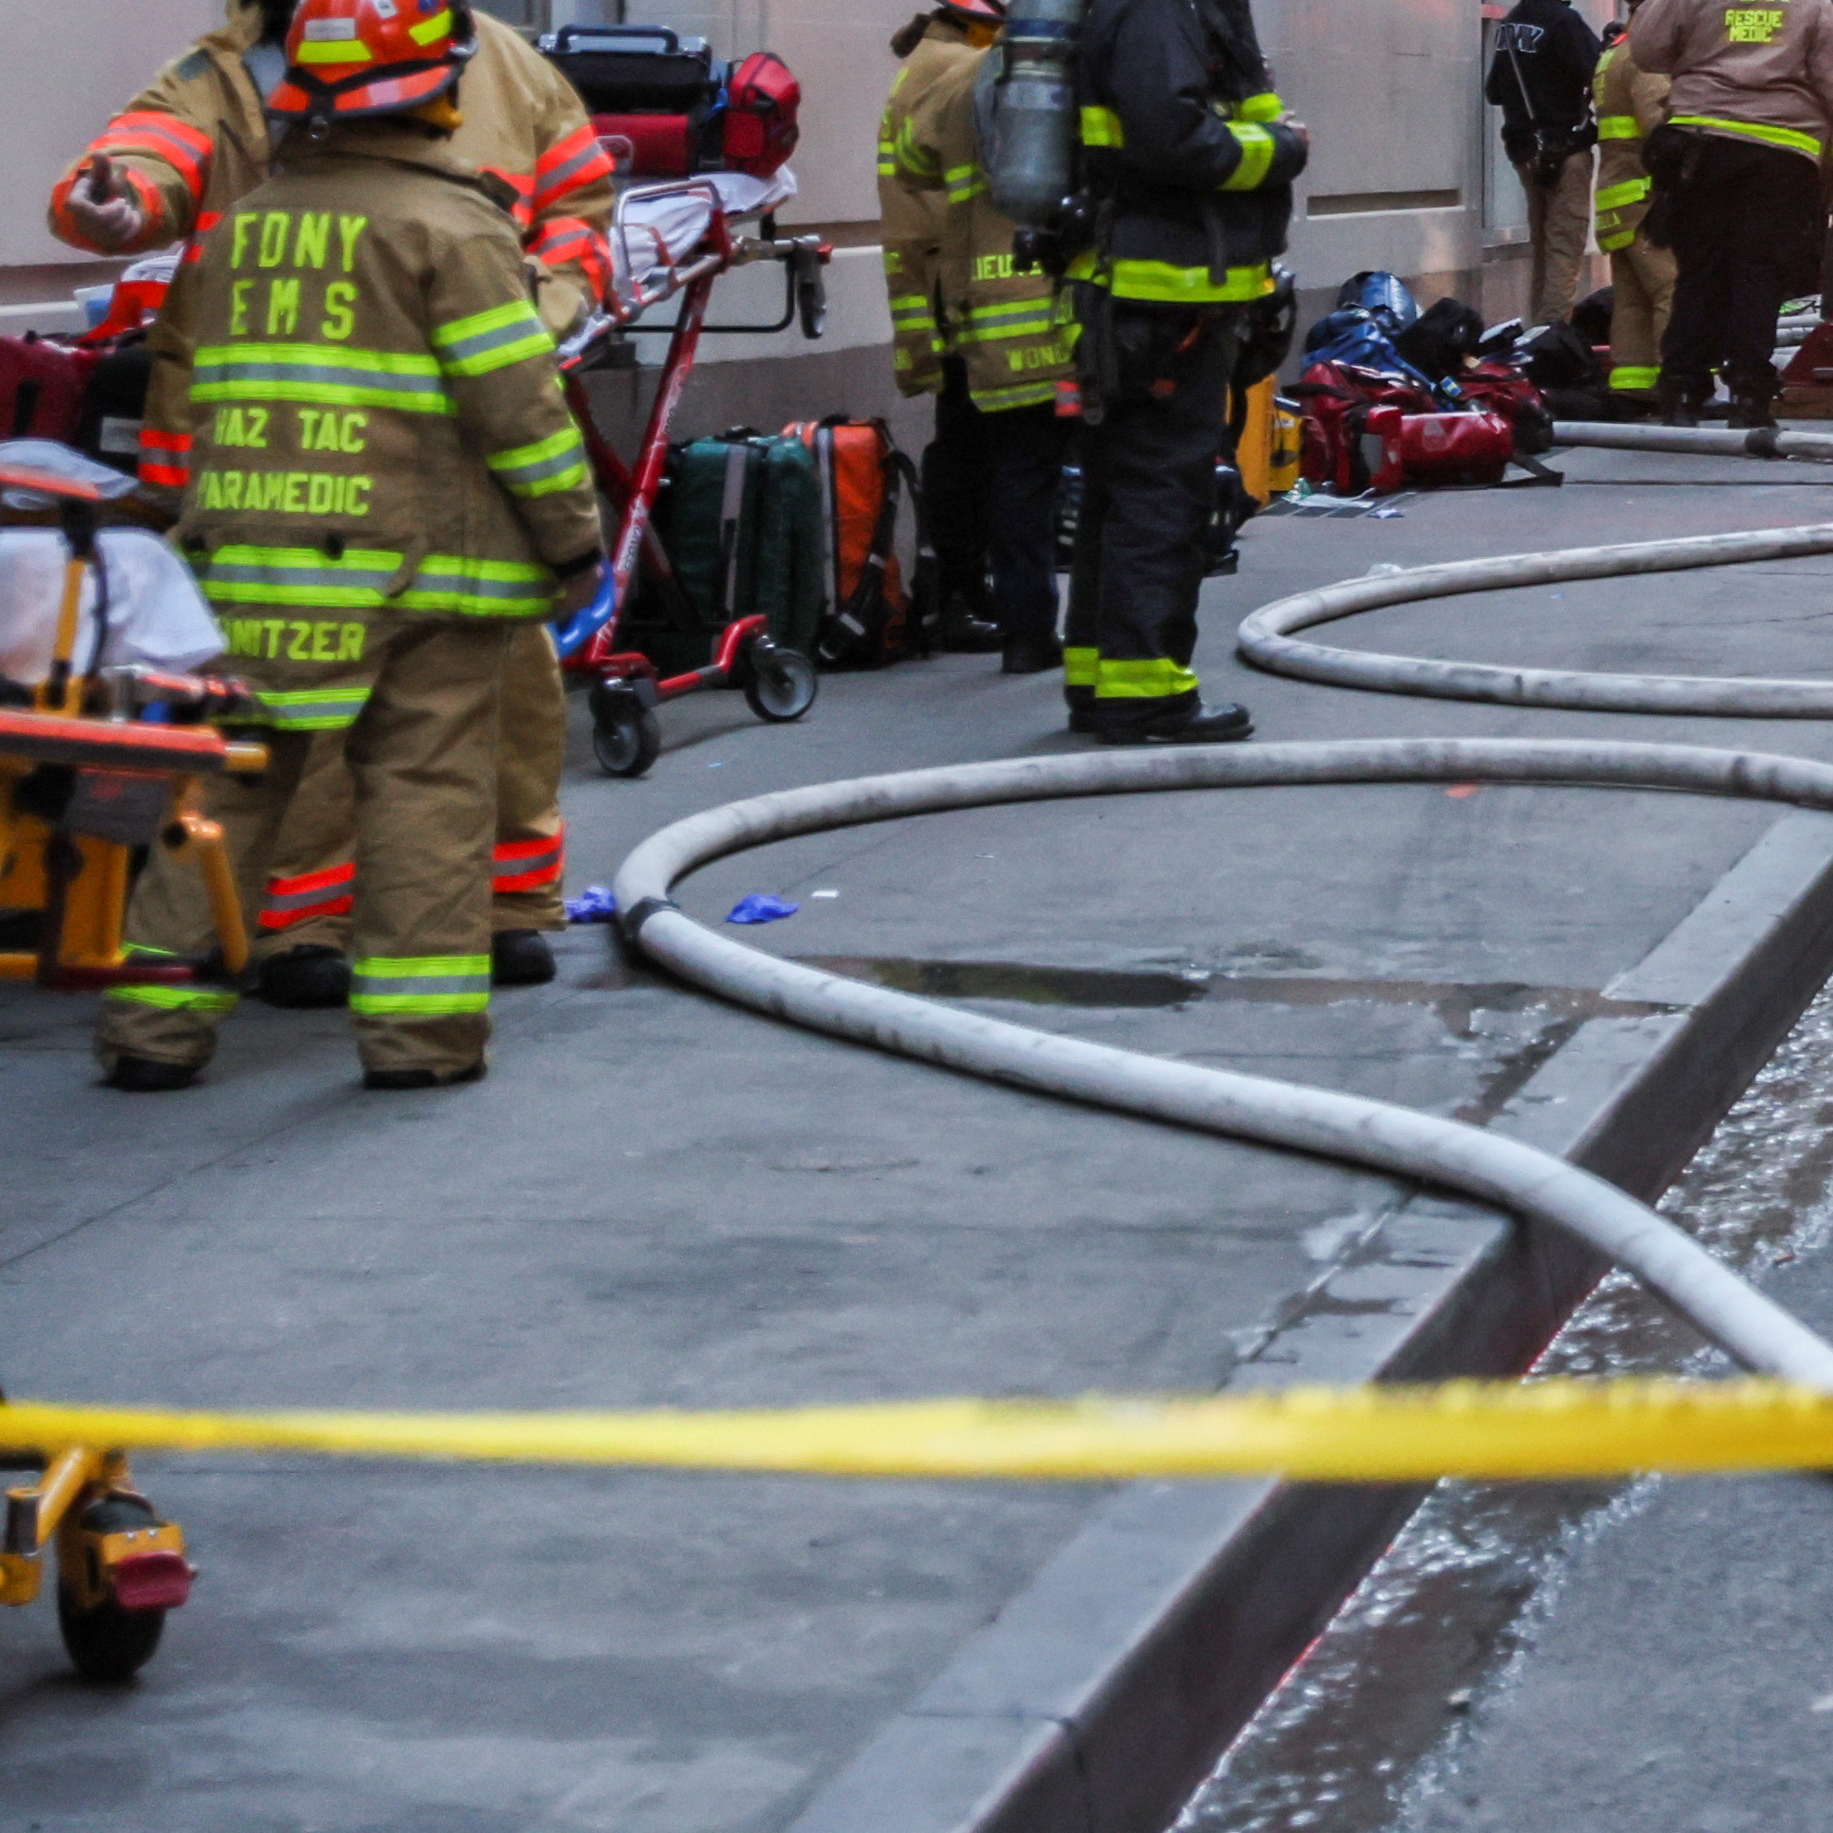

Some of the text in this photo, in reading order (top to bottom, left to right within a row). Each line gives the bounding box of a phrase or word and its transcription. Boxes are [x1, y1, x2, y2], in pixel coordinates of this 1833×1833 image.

[1725, 9, 1783, 27] RESCUE
[1729, 25, 1773, 42] MEDIC
[230, 212, 368, 272] FDNY
[230, 279, 357, 340] EMS
[214, 408, 369, 453] HAZ TAC
